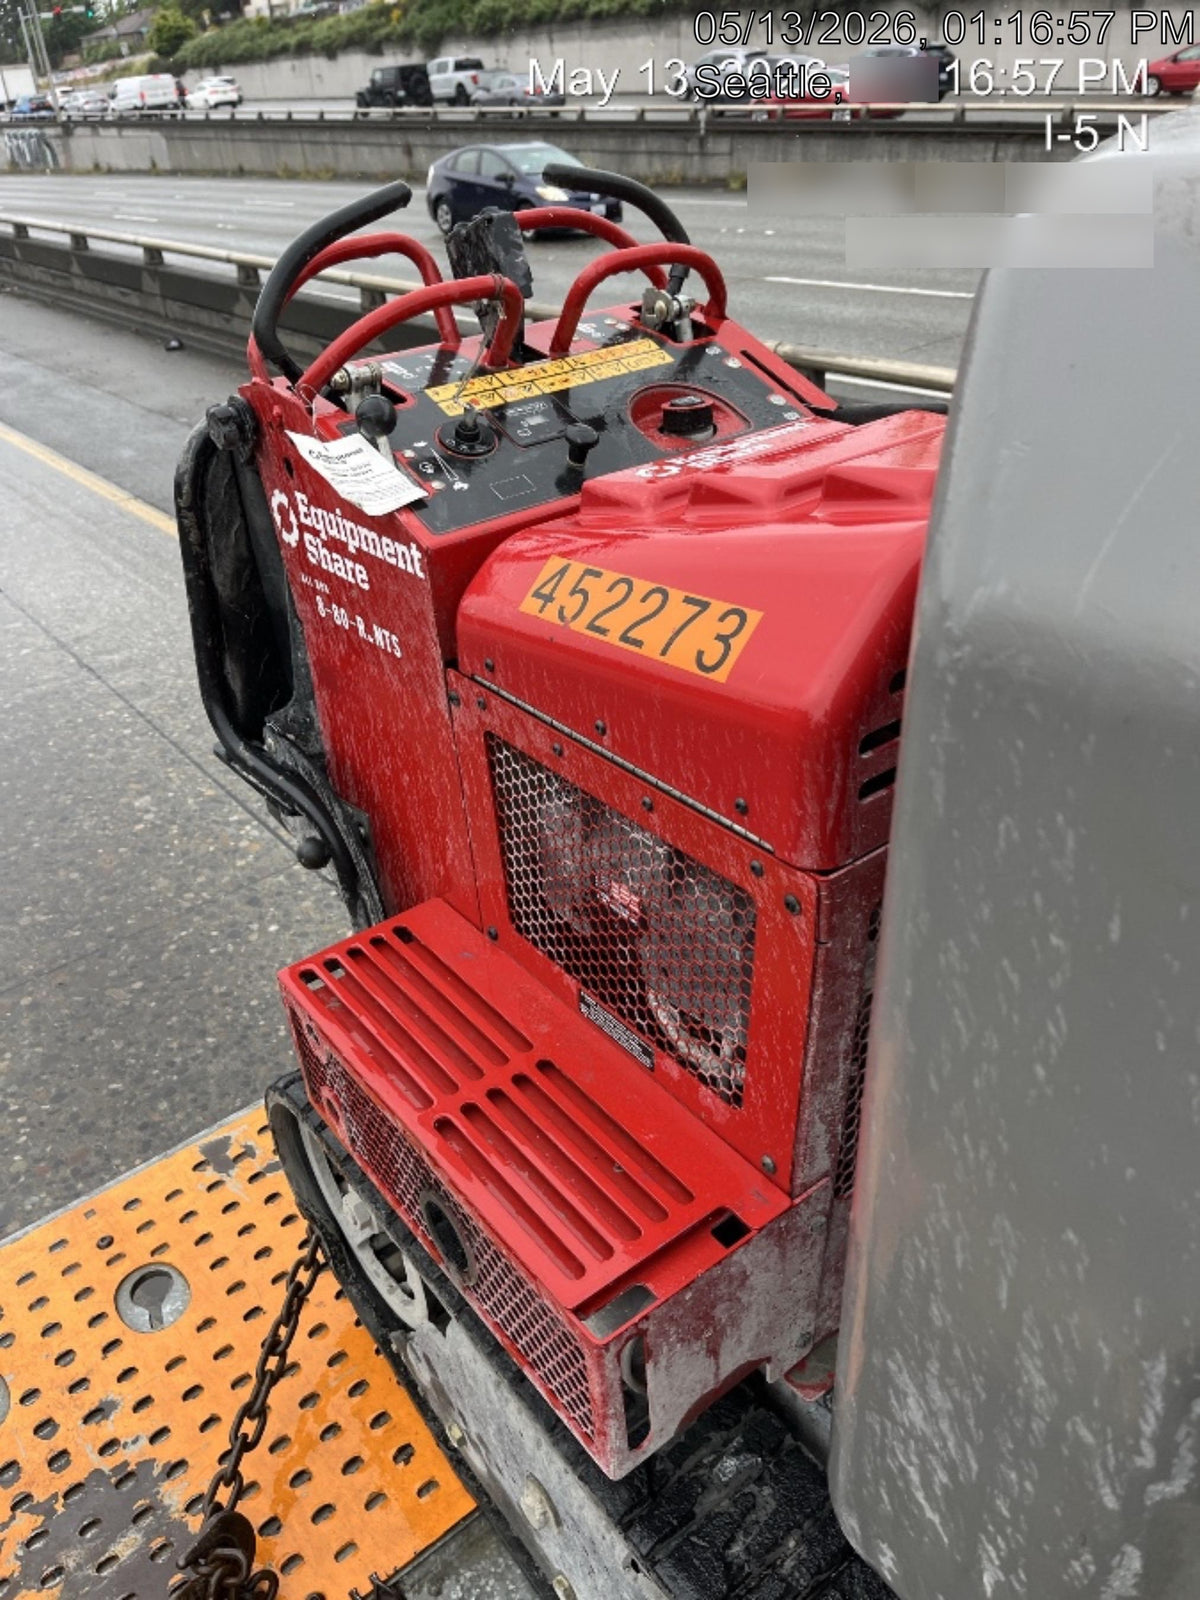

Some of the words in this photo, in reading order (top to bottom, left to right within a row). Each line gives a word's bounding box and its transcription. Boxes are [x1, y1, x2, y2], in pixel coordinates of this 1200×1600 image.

[294, 490, 425, 580] Equipment
[303, 531, 370, 591] Share
[531, 563, 748, 674] 452273
